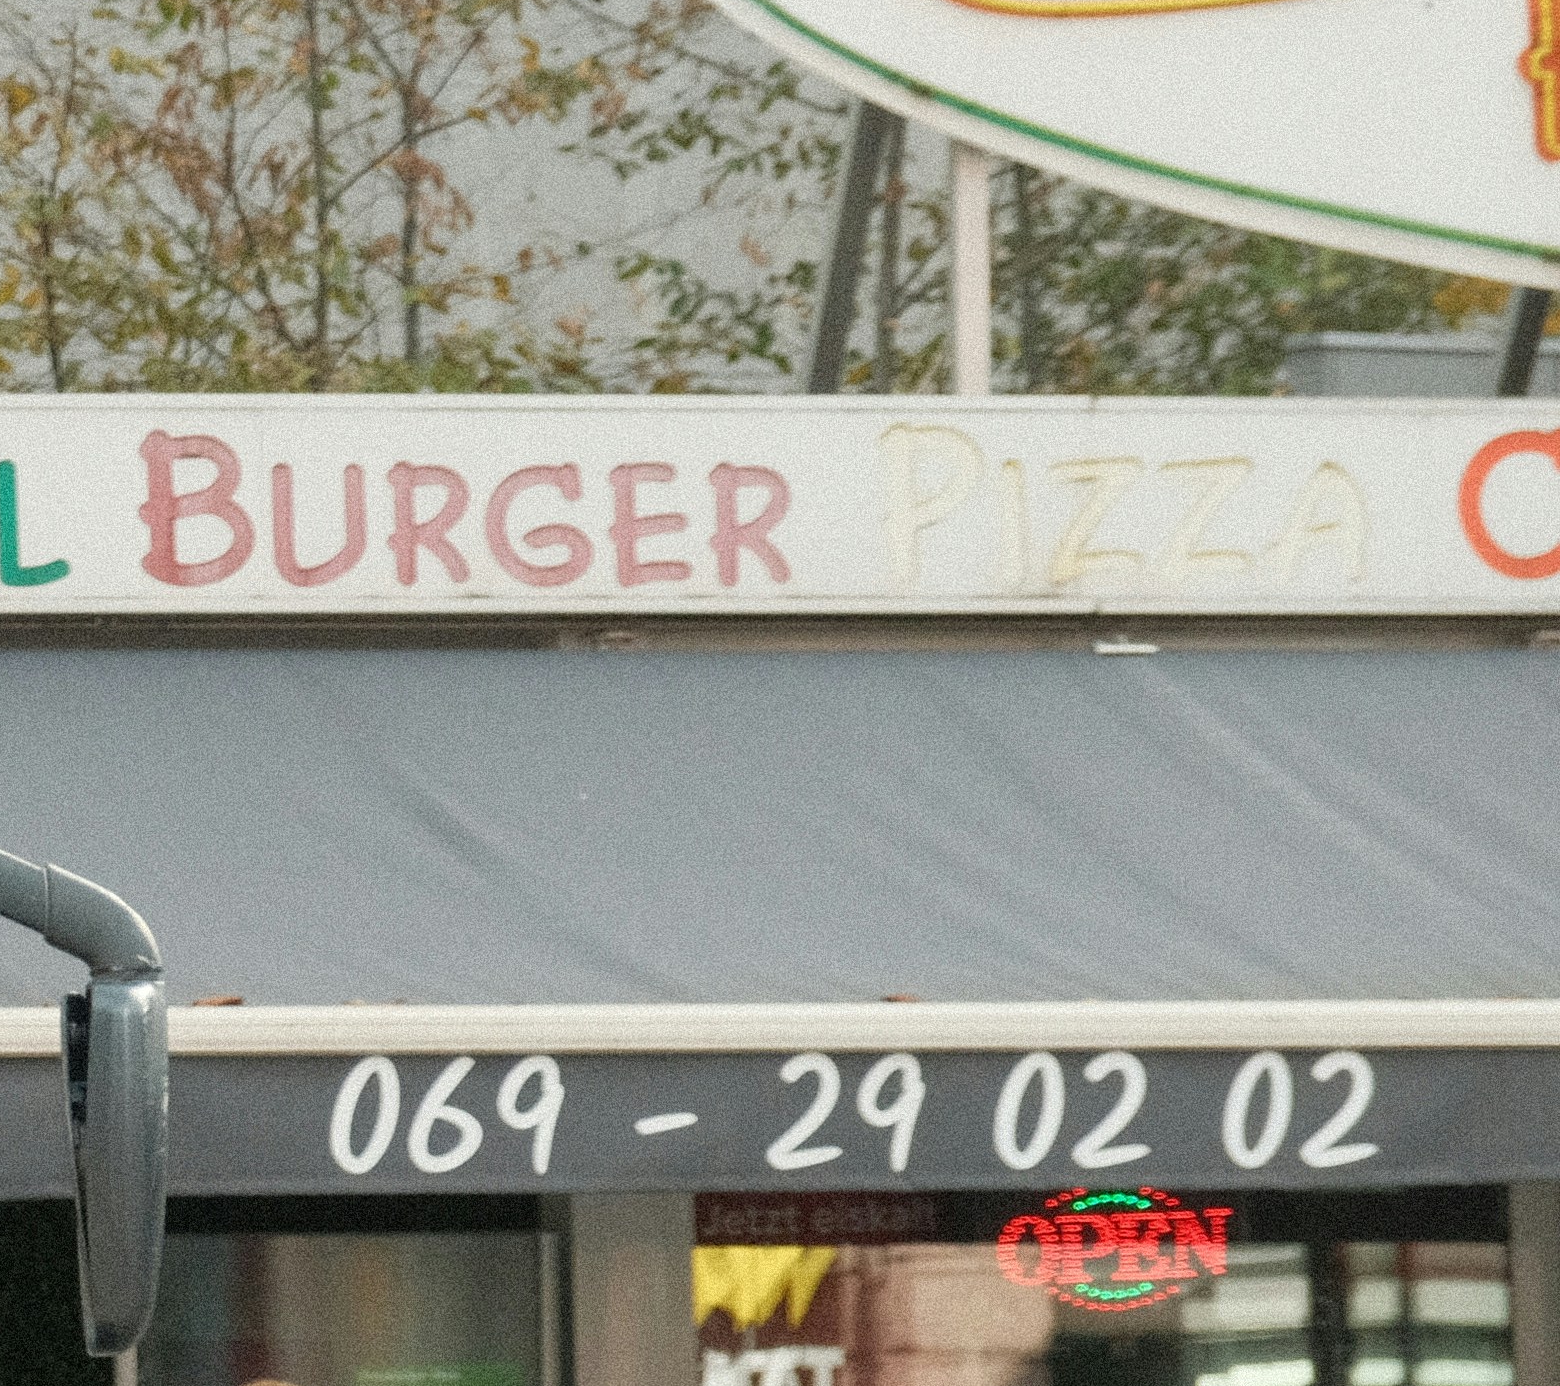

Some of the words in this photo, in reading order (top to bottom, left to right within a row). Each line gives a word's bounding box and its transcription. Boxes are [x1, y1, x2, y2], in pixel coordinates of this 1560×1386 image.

[138, 428, 792, 589] BURGER
[876, 421, 1370, 588] PIZZA
[328, 1053, 566, 1176] 069
[765, 1051, 927, 1174] 29
[992, 1050, 1152, 1172] 02
[1221, 1050, 1380, 1171] 02
[996, 1207, 1233, 1289] OPEN
